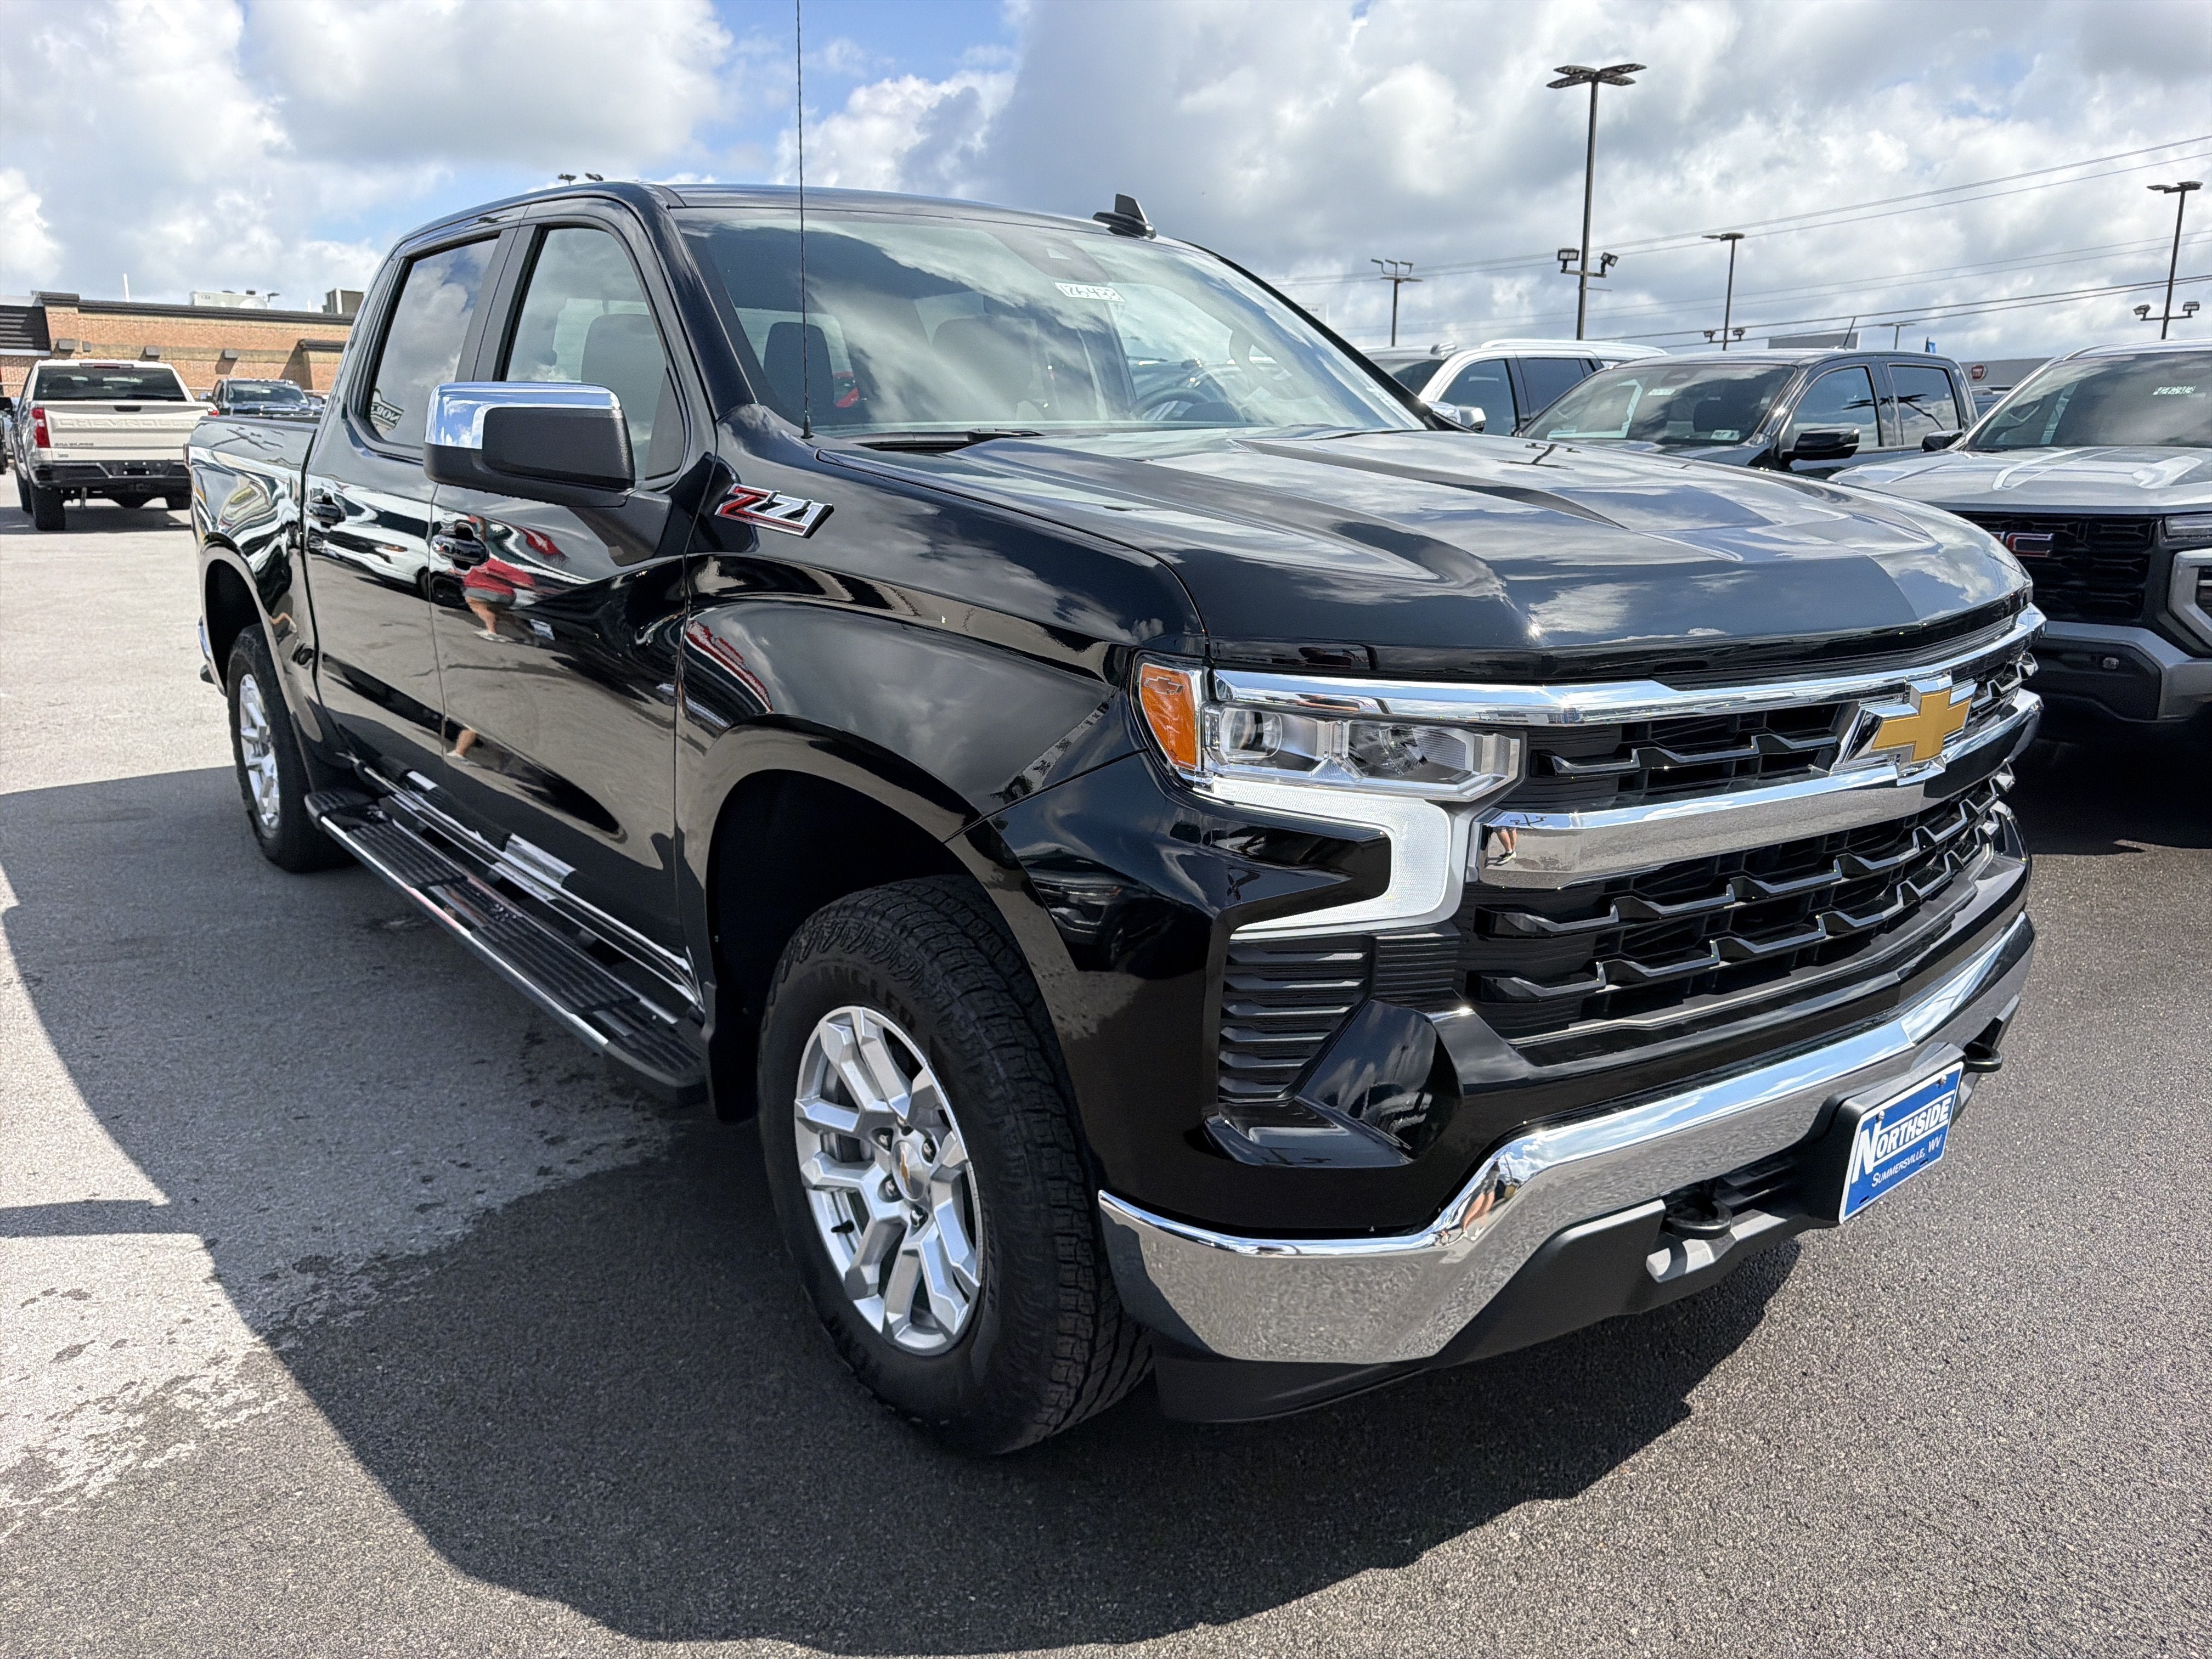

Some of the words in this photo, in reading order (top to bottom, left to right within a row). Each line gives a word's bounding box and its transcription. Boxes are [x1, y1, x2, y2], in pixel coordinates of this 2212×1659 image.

[715, 483, 834, 538] Z71
[1851, 1097, 1951, 1184] NORTHSIDE
[1928, 1133, 1943, 1153] WV
